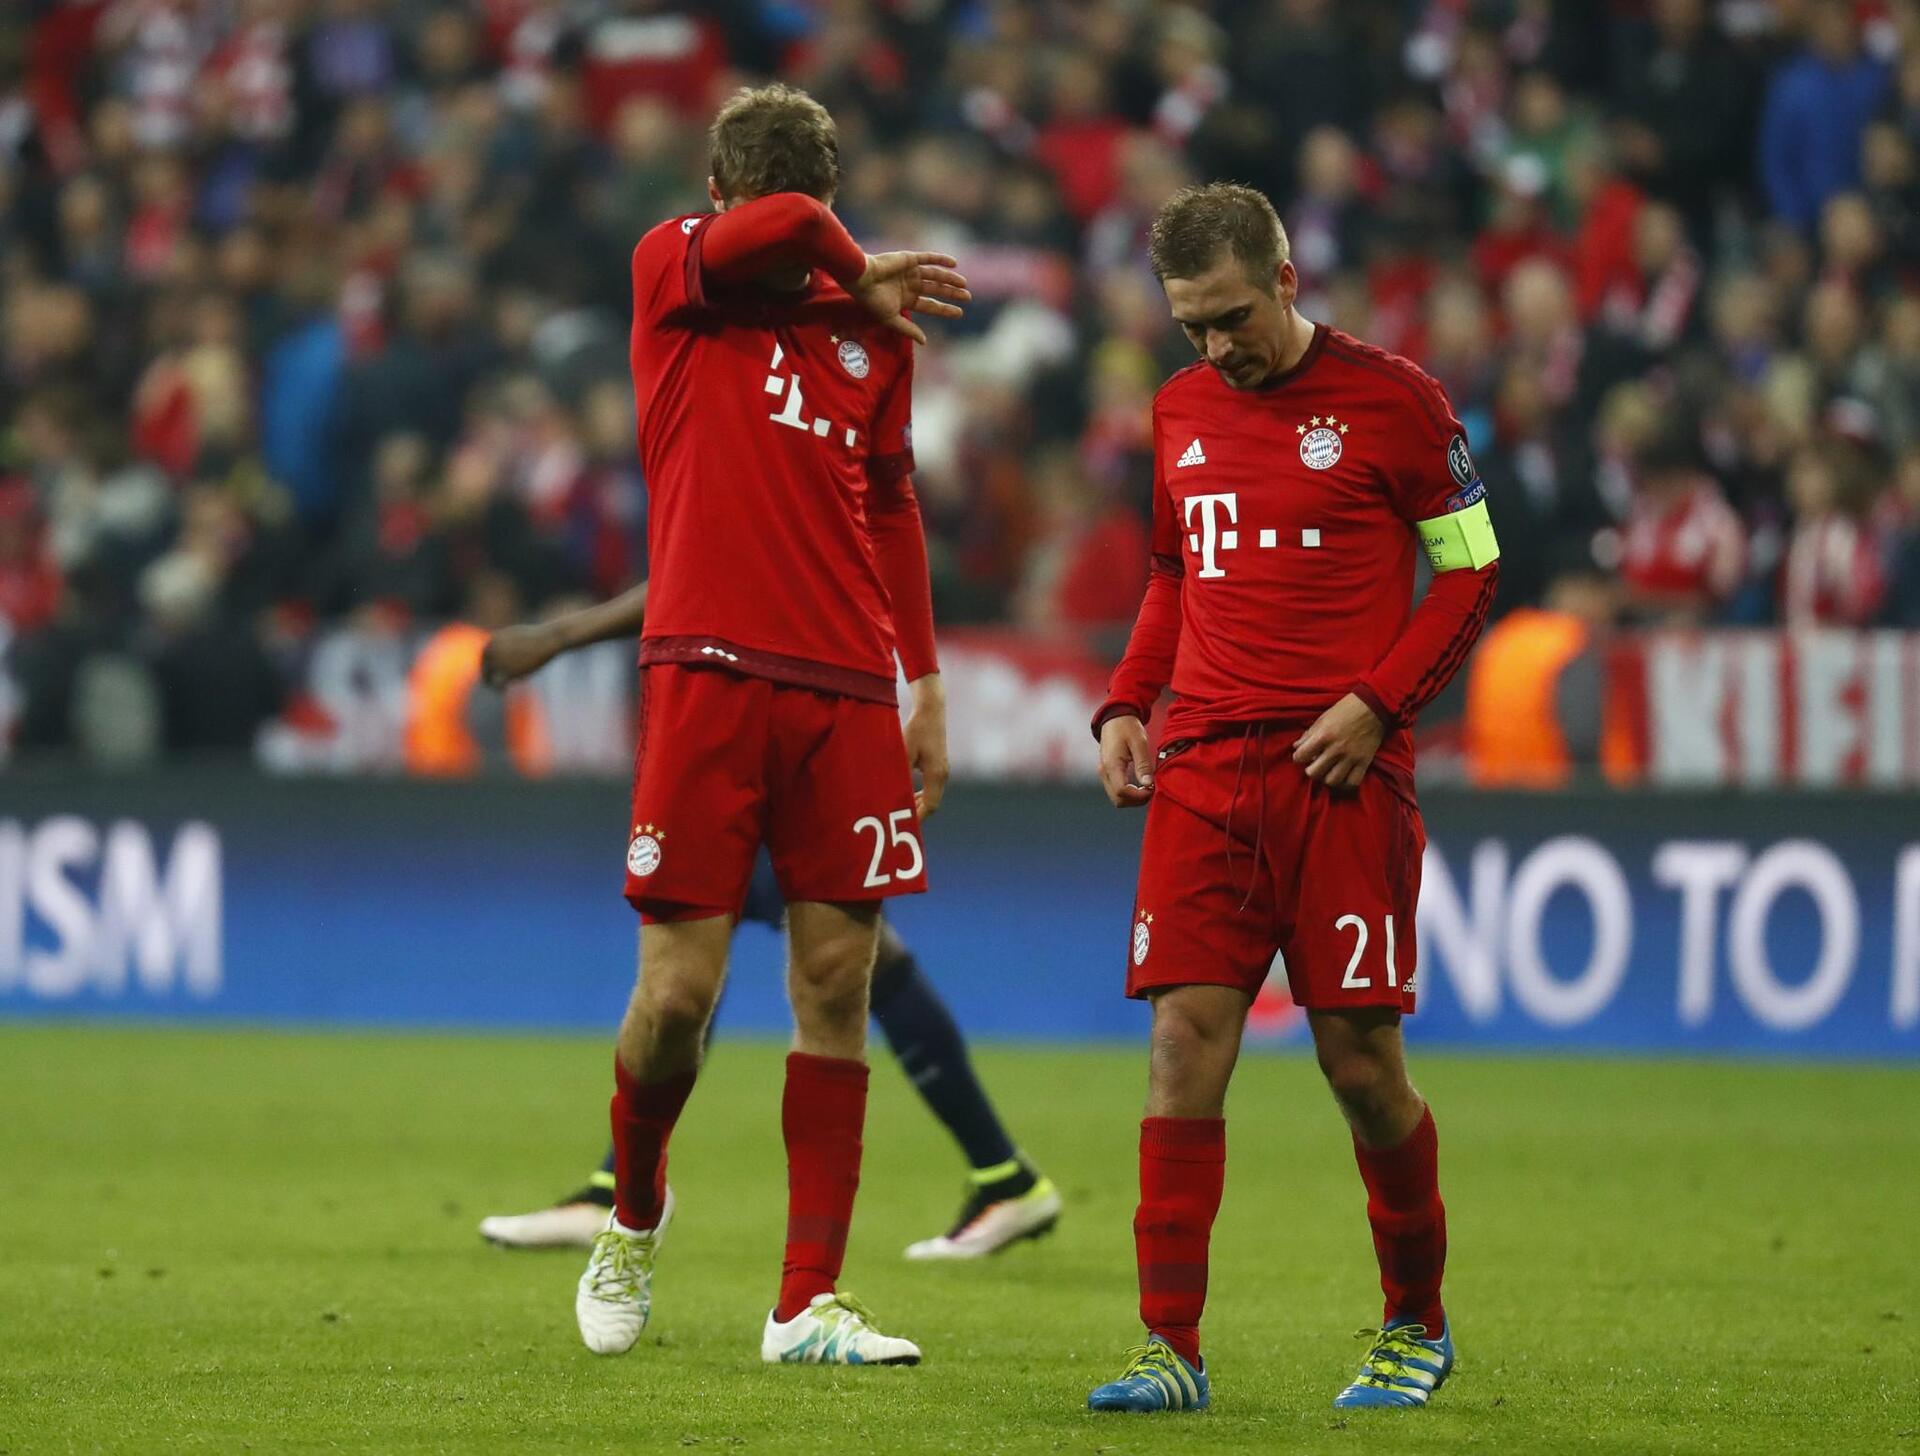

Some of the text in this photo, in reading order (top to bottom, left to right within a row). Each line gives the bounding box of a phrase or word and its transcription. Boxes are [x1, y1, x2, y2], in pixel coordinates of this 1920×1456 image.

[1177, 455, 1206, 468] adidas
[853, 808, 923, 888] 25
[0, 813, 224, 1000] ISM
[1416, 834, 1633, 1030] NO
[1650, 836, 1861, 1032] TO
[1335, 914, 1397, 989] 21
